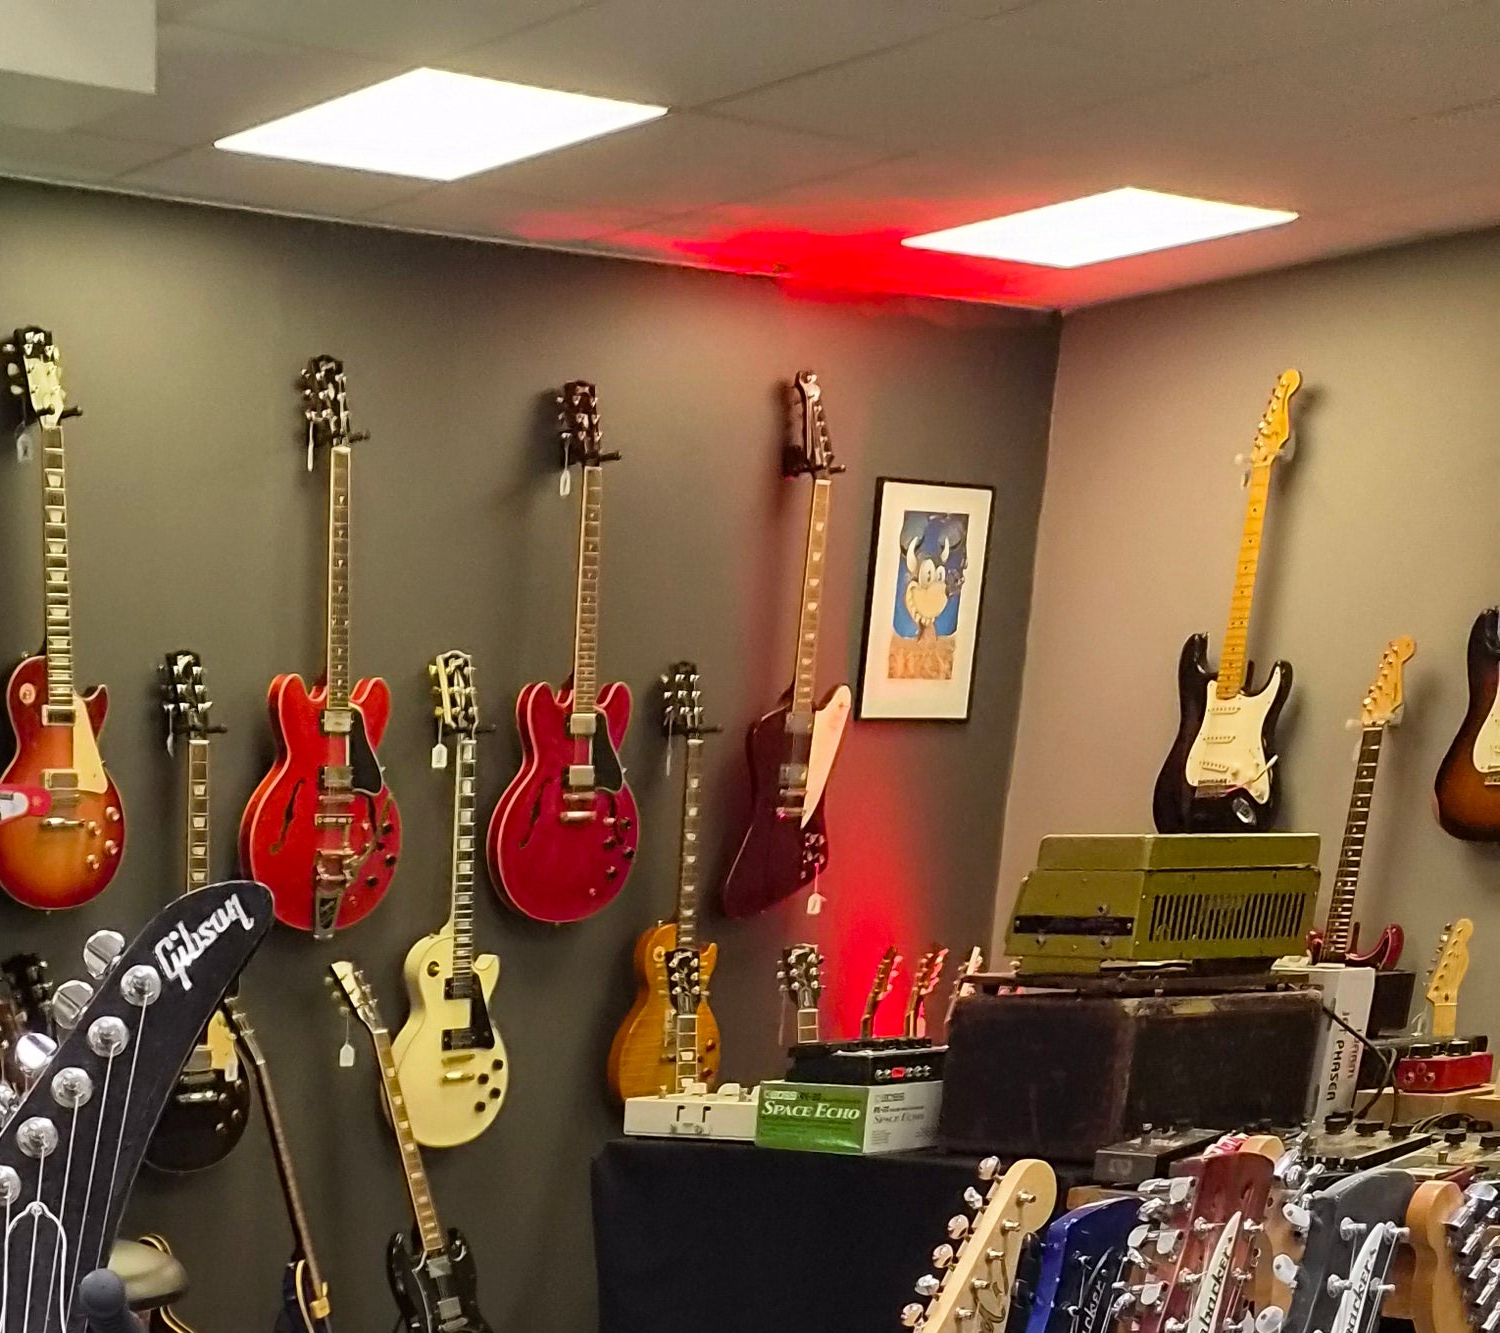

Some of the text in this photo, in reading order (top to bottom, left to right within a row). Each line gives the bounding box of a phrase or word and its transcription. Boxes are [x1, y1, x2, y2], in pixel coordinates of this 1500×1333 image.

[155, 893, 255, 991] Gibson
[762, 1100, 861, 1121] SPACE ECHO
